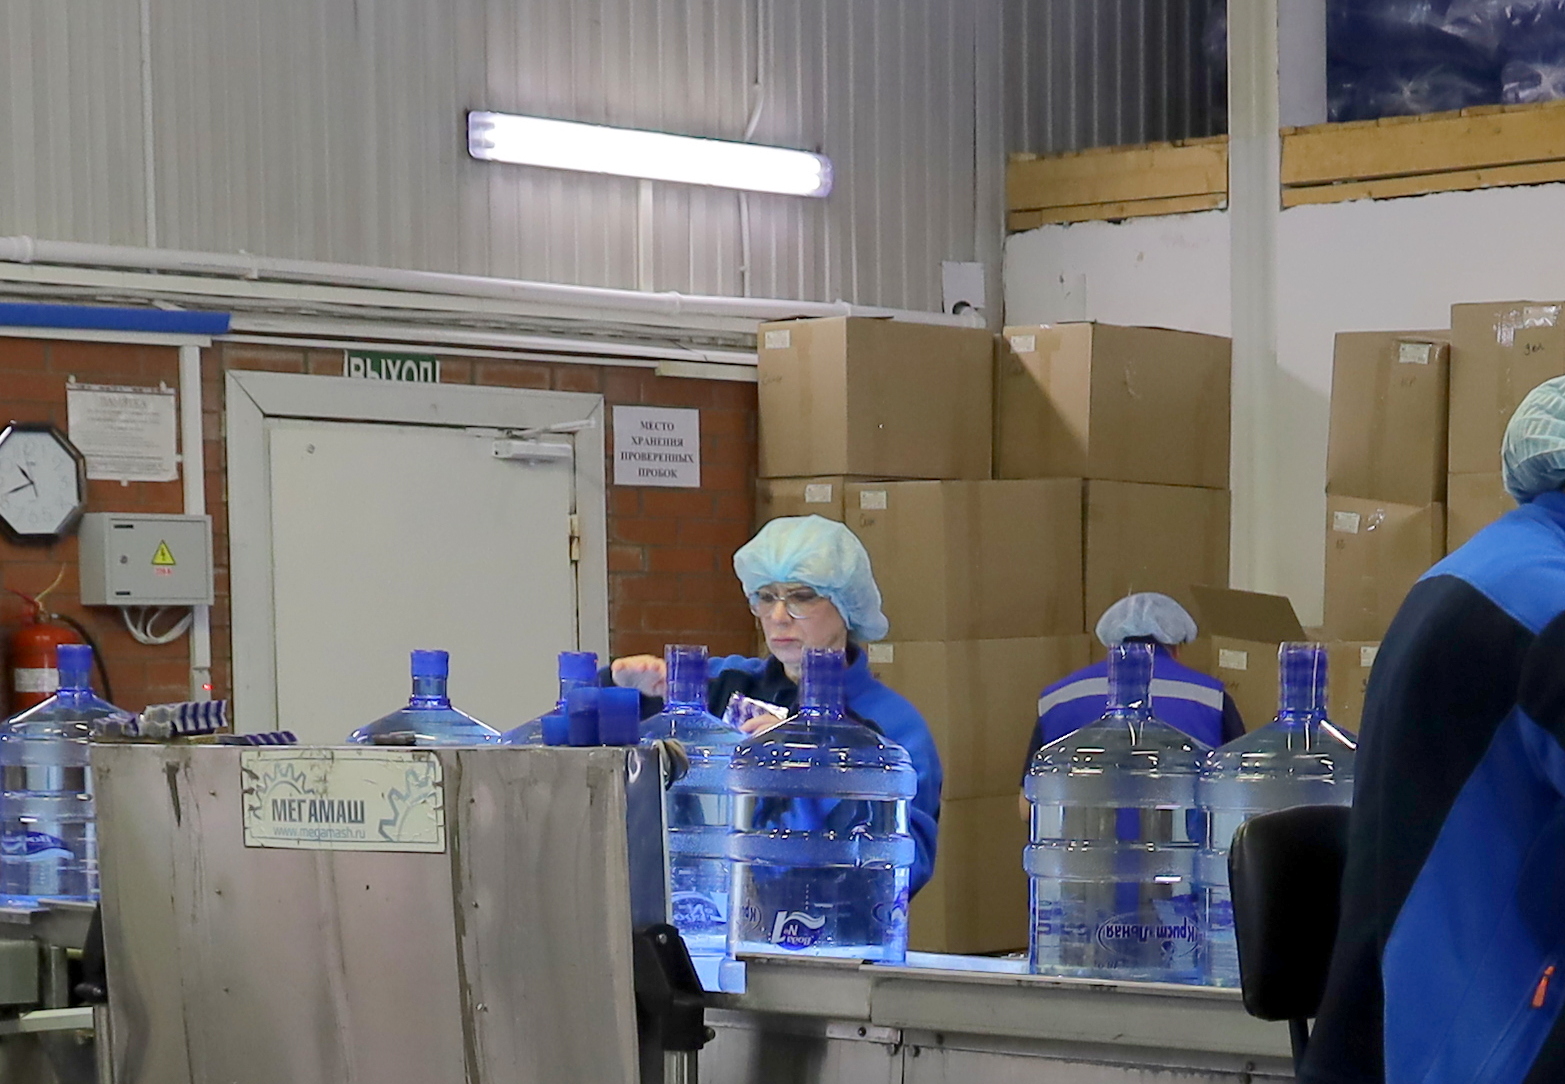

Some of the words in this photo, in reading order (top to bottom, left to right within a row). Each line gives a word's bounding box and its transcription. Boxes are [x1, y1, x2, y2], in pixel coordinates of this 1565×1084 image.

[640, 420, 675, 431] МЕСТО
[631, 435, 684, 447] ХРАНЕНИЯ
[620, 451, 695, 463] ПРОВЕРЕННЫХ
[637, 467, 678, 479] ПРОБОК
[271, 799, 366, 824] МЕГАМАШ
[273, 825, 366, 839] www.megamash.ru
